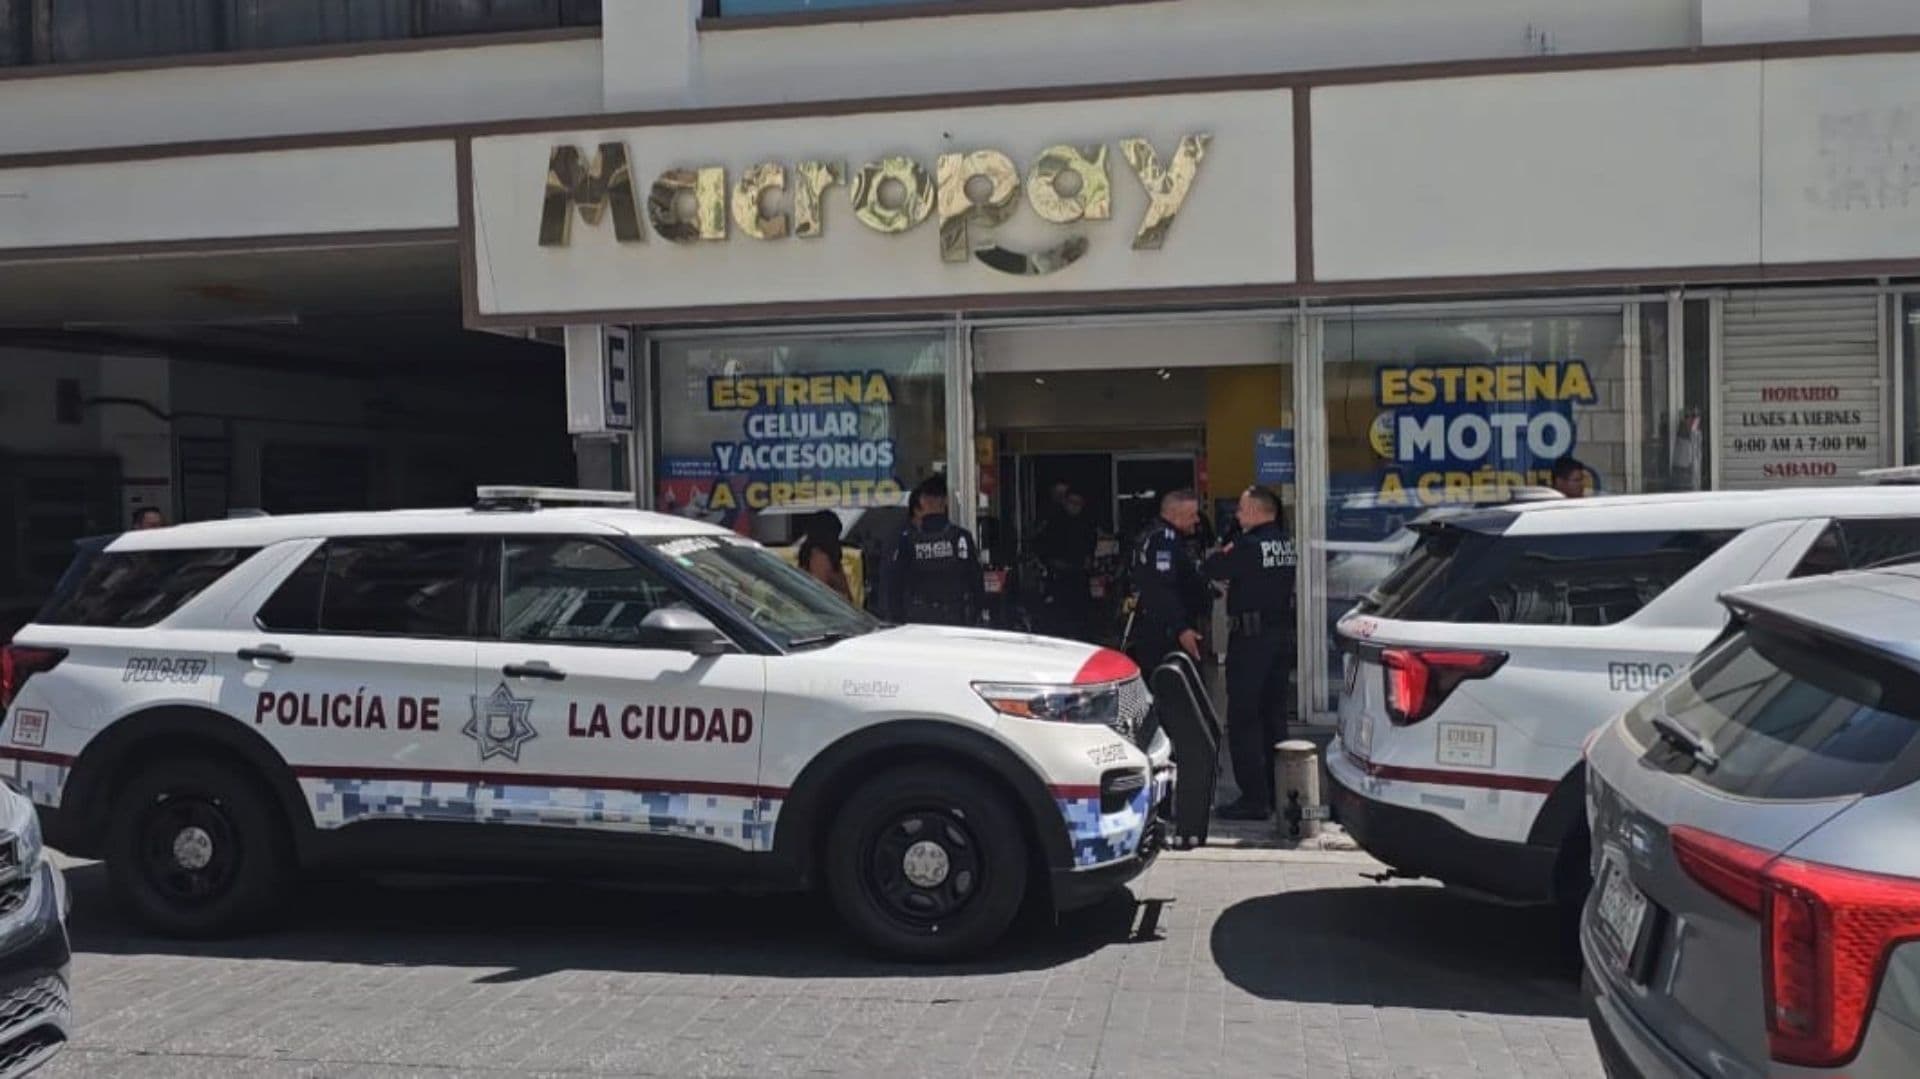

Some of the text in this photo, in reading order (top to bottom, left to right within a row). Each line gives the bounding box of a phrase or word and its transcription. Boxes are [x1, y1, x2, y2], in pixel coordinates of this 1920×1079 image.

[538, 132, 1214, 265] Macropay
[711, 373, 893, 407] ESTRENA
[1381, 363, 1593, 404] ESTRENA
[1761, 385, 1839, 403] HORARIO
[749, 411, 857, 438] CELULAR
[1742, 409, 1861, 426] LUNES A VIERNES
[1398, 411, 1572, 461] MOTO
[1734, 435, 1866, 452] 9:00 AM A 7:00 PM
[715, 445, 733, 470] Y
[740, 442, 894, 470] ACCESORIOS
[709, 475, 900, 509] A CRÉDITO
[1378, 472, 1408, 504] A
[255, 686, 753, 743] POLICÍA DE LA CIUDAD
